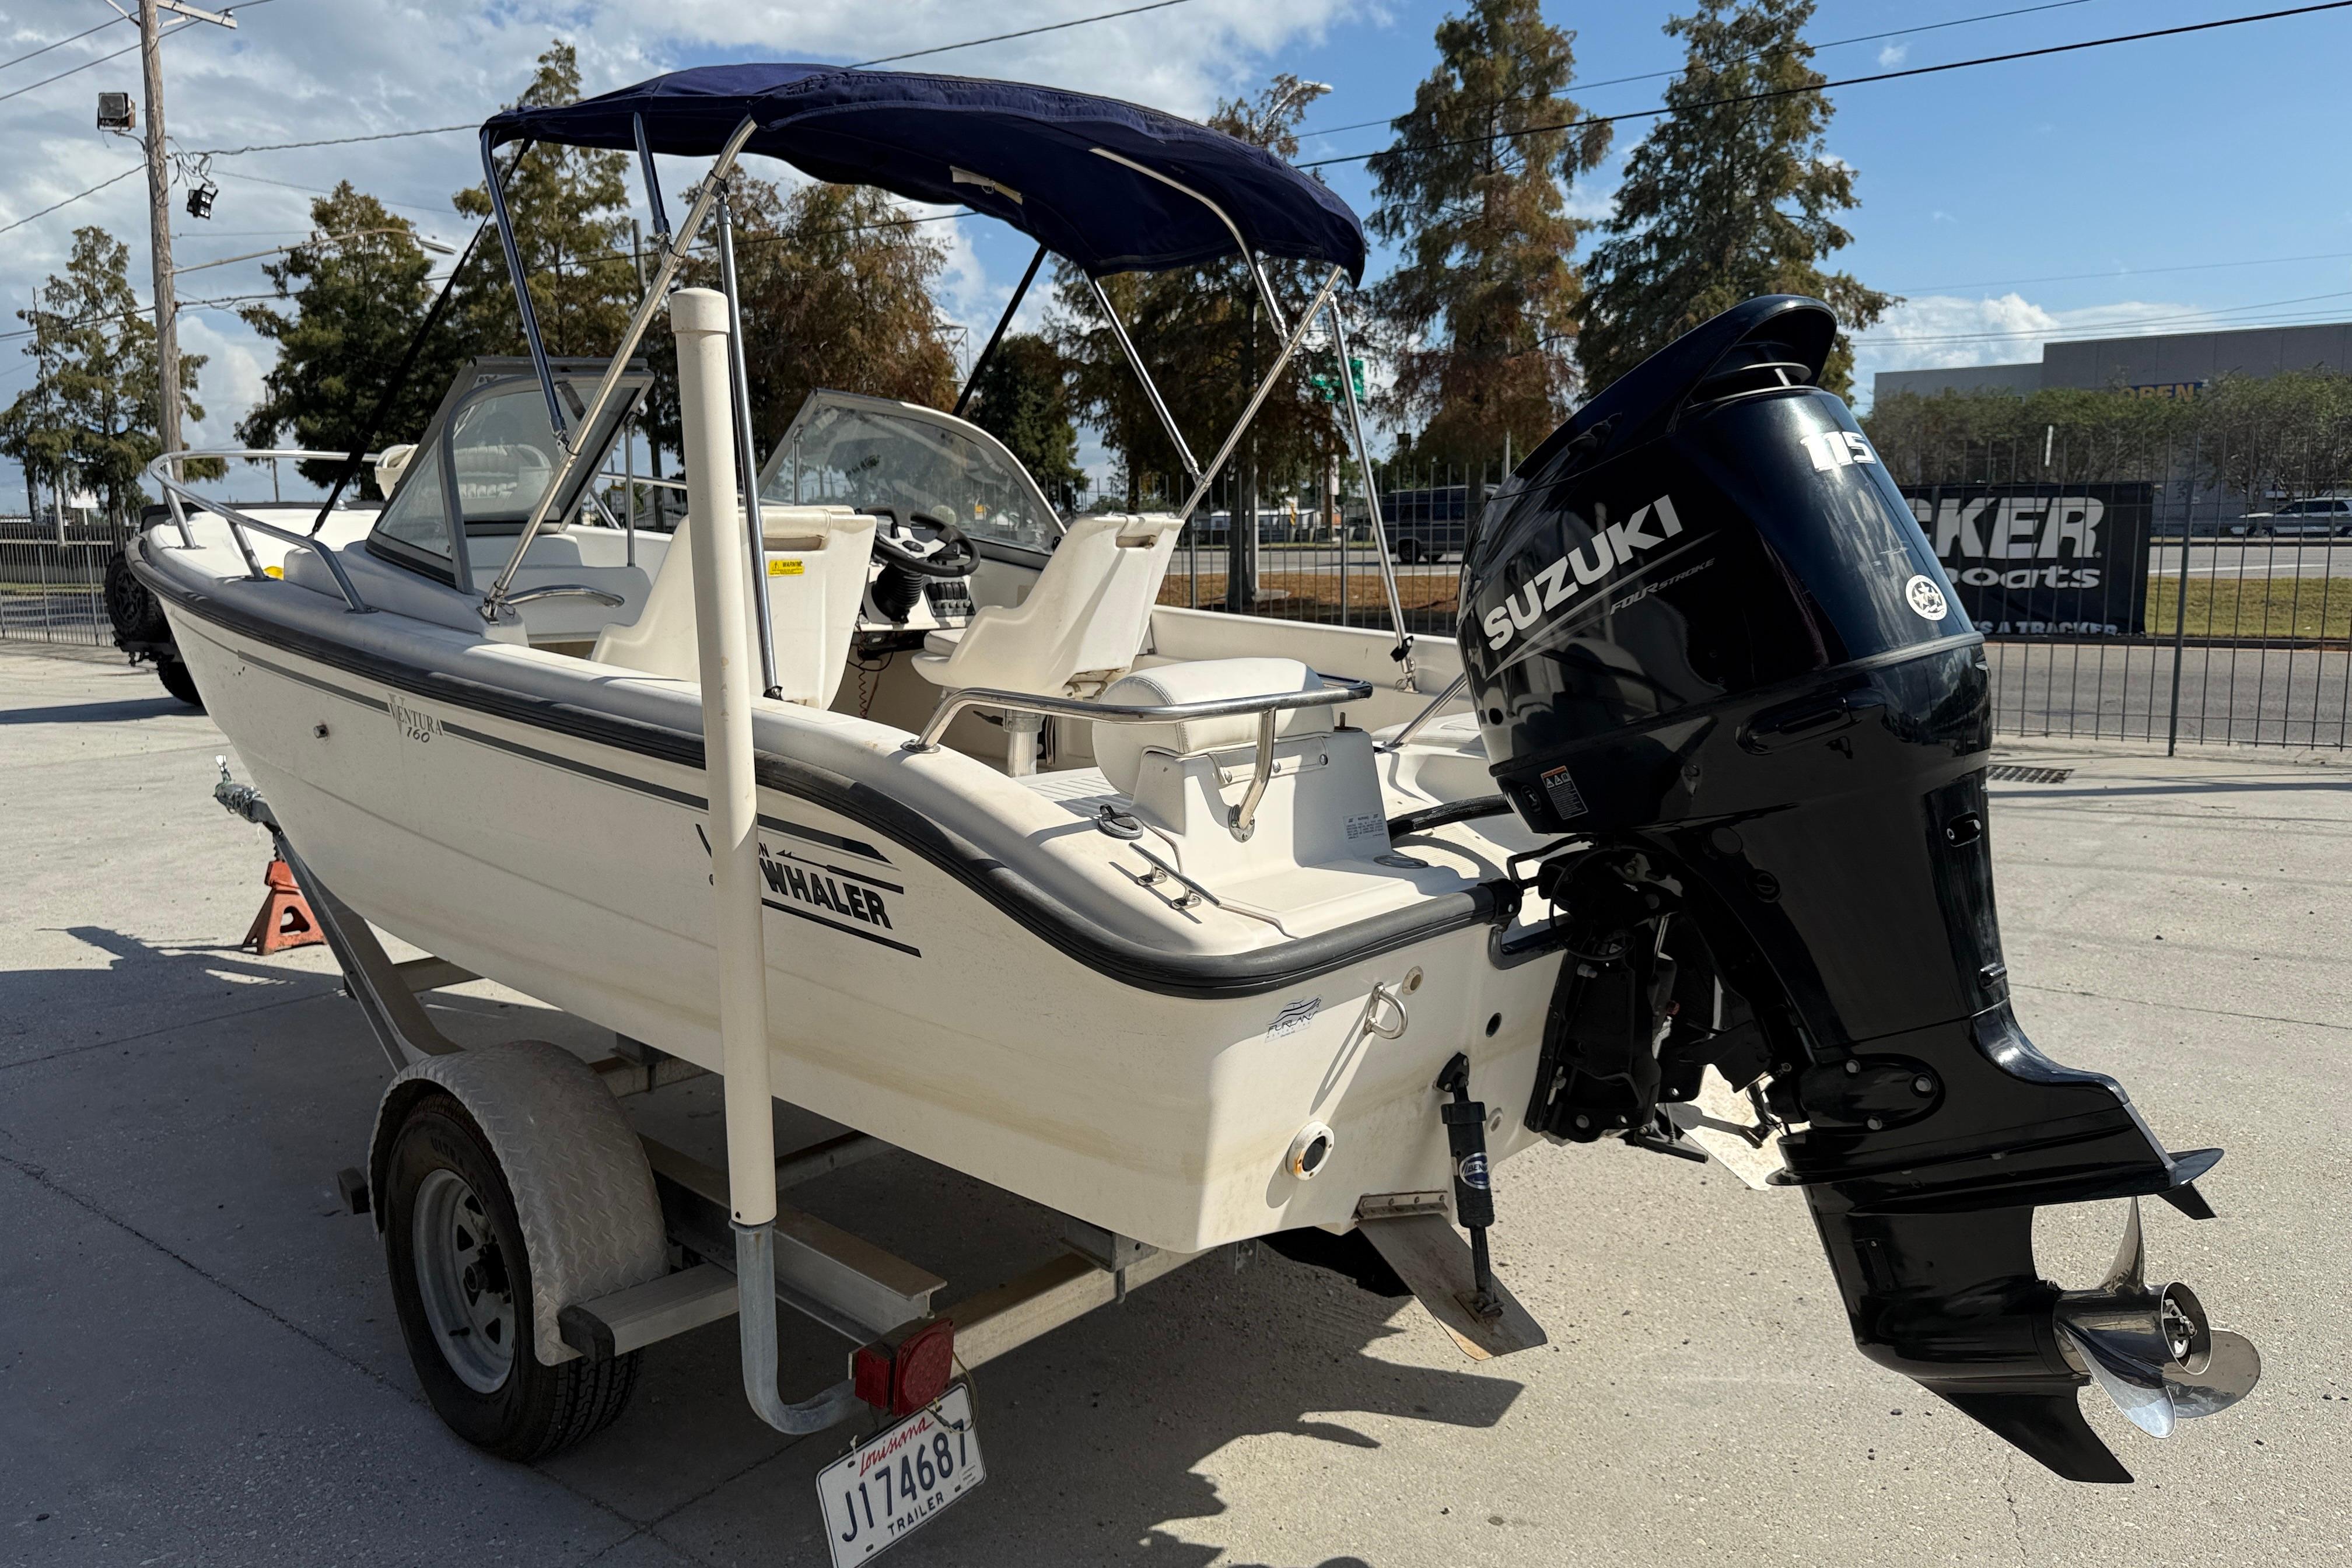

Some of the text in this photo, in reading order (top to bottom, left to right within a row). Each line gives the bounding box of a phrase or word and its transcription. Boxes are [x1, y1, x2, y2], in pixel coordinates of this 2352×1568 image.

[1800, 431, 1877, 472] 115
[1483, 495, 1683, 650] SUZUKI
[389, 700, 443, 736] VENTURA
[407, 727, 430, 743] 160
[759, 858, 893, 930] WHALER
[860, 1417, 935, 1477] Louisiana
[842, 1418, 966, 1542] J174687
[888, 1491, 944, 1536] TRAILER
